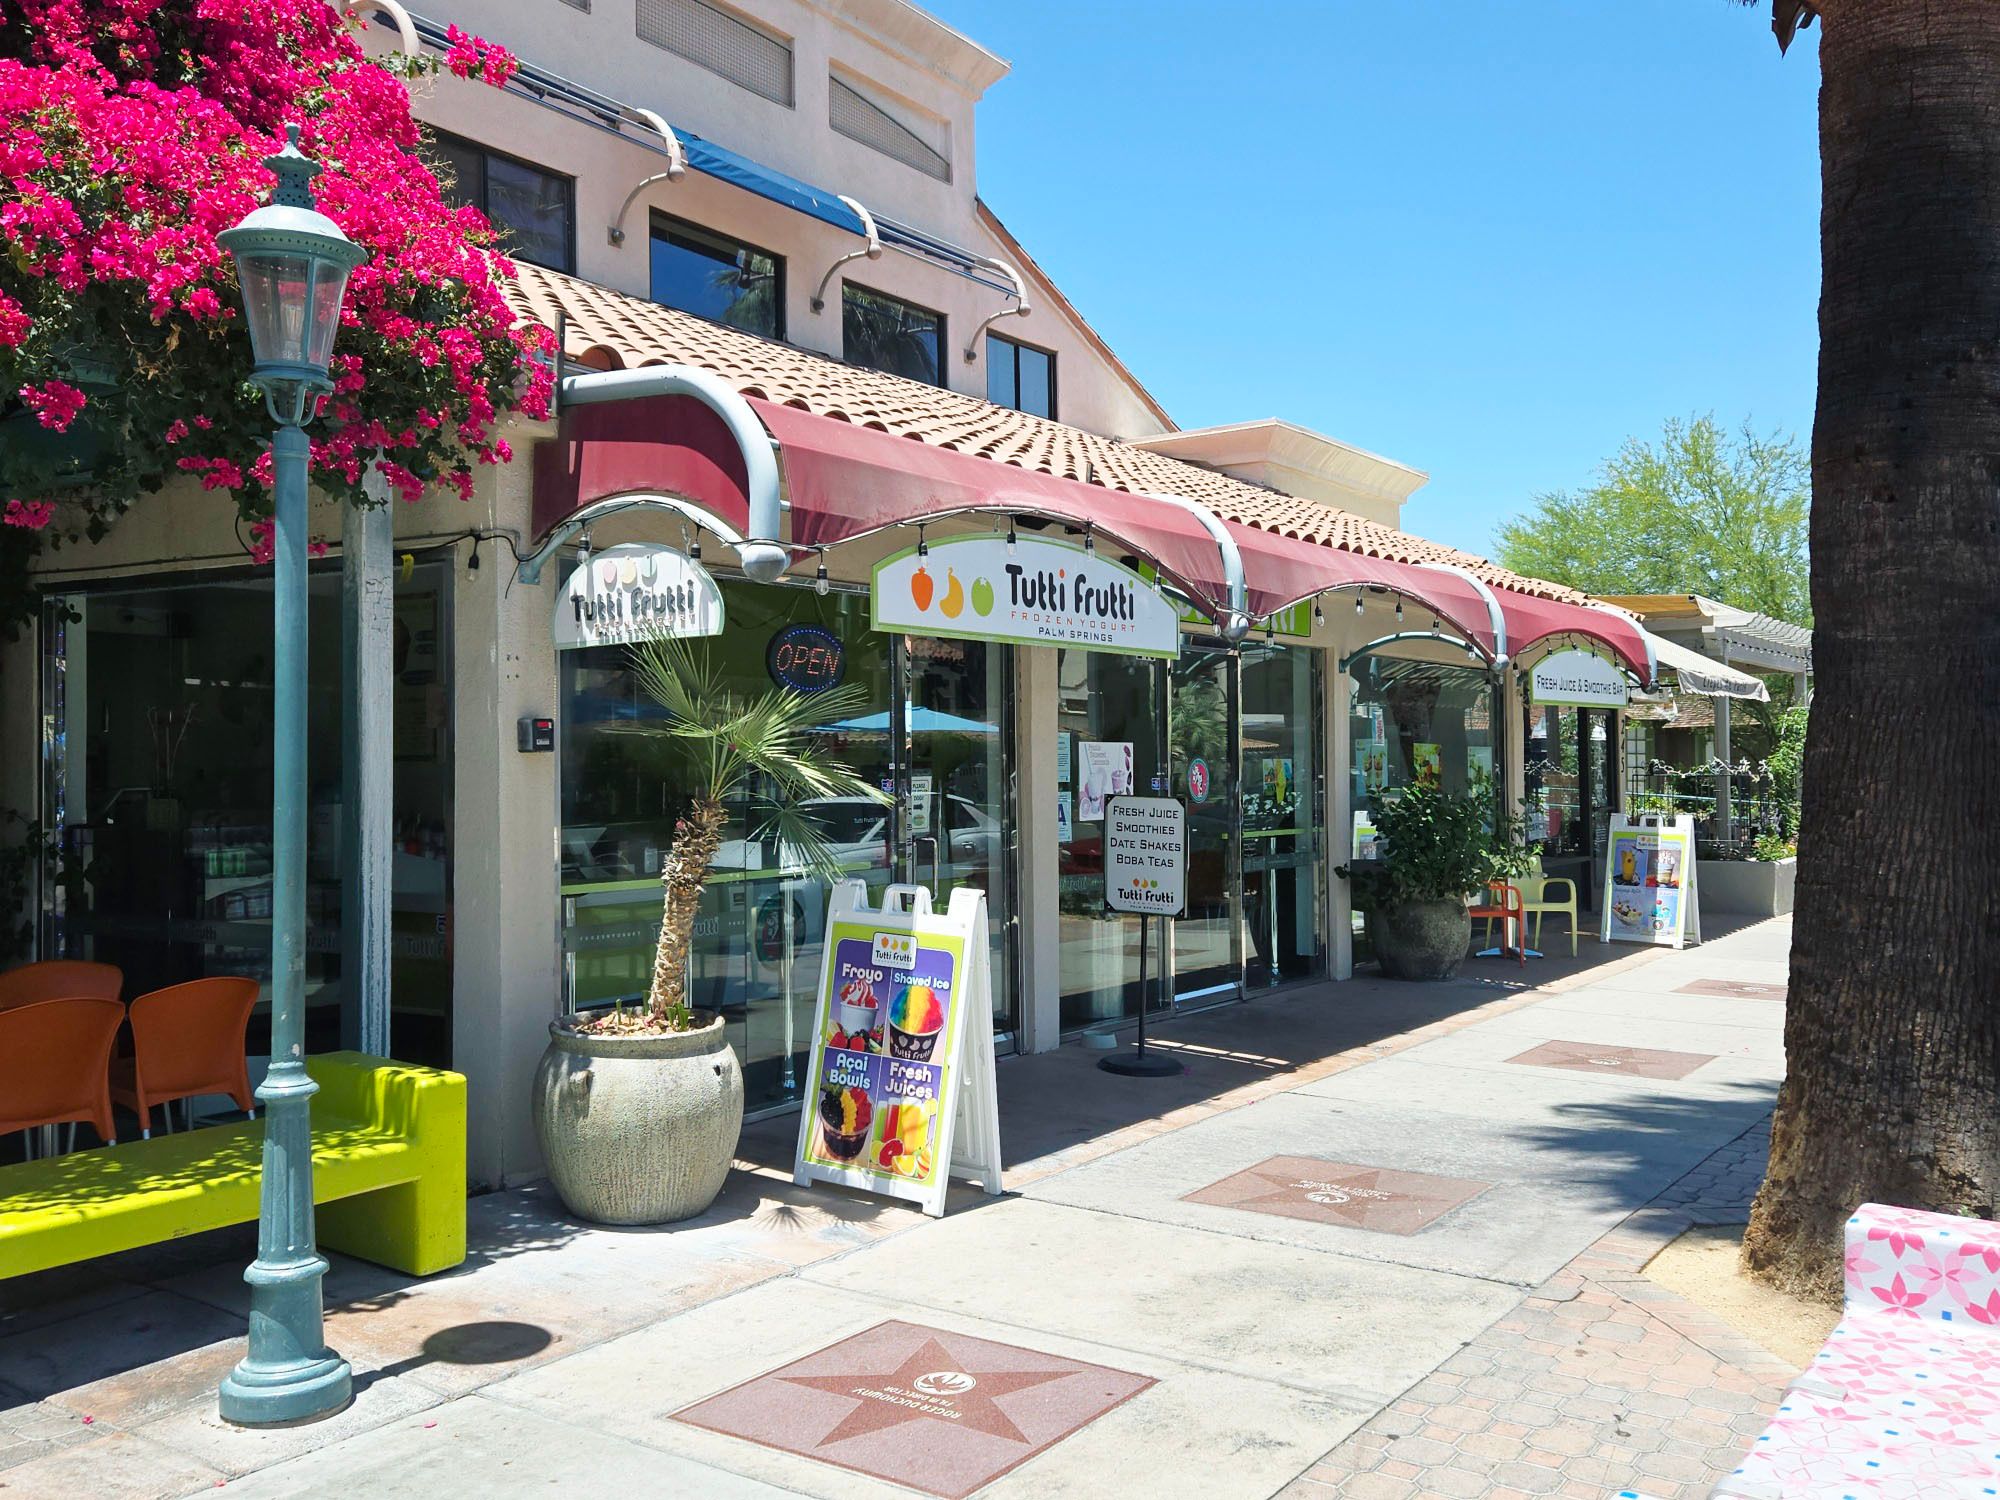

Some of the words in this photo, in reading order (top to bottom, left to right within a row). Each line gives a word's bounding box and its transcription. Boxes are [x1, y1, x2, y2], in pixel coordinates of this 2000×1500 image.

[1005, 564, 1066, 612] Tutti
[570, 587, 623, 622] Tutti
[1011, 611, 1073, 625] FROZEN
[1080, 618, 1137, 632] YOGURT
[1038, 626, 1065, 638] PALM
[1070, 629, 1113, 643] SPRINGS
[776, 643, 840, 677] OPEN
[1537, 674, 1558, 691] FRESH
[1559, 676, 1576, 692] JUICE
[1578, 678, 1582, 692] &
[1612, 682, 1624, 696] BAR
[1117, 888, 1142, 901] Tutti
[875, 950, 892, 960] Tutti
[842, 963, 883, 985] Froyo
[894, 972, 931, 987] Shaved
[932, 976, 949, 990] Ice
[894, 1044, 911, 1059] Tutti
[836, 1053, 868, 1073] Açai
[889, 1062, 932, 1083] Fresh
[829, 1069, 871, 1089] Bowls
[885, 1079, 933, 1100] Juices
[884, 1385, 930, 1401] DIRECTOR
[929, 1397, 954, 1407] FILM
[920, 1403, 962, 1419] ROGER
